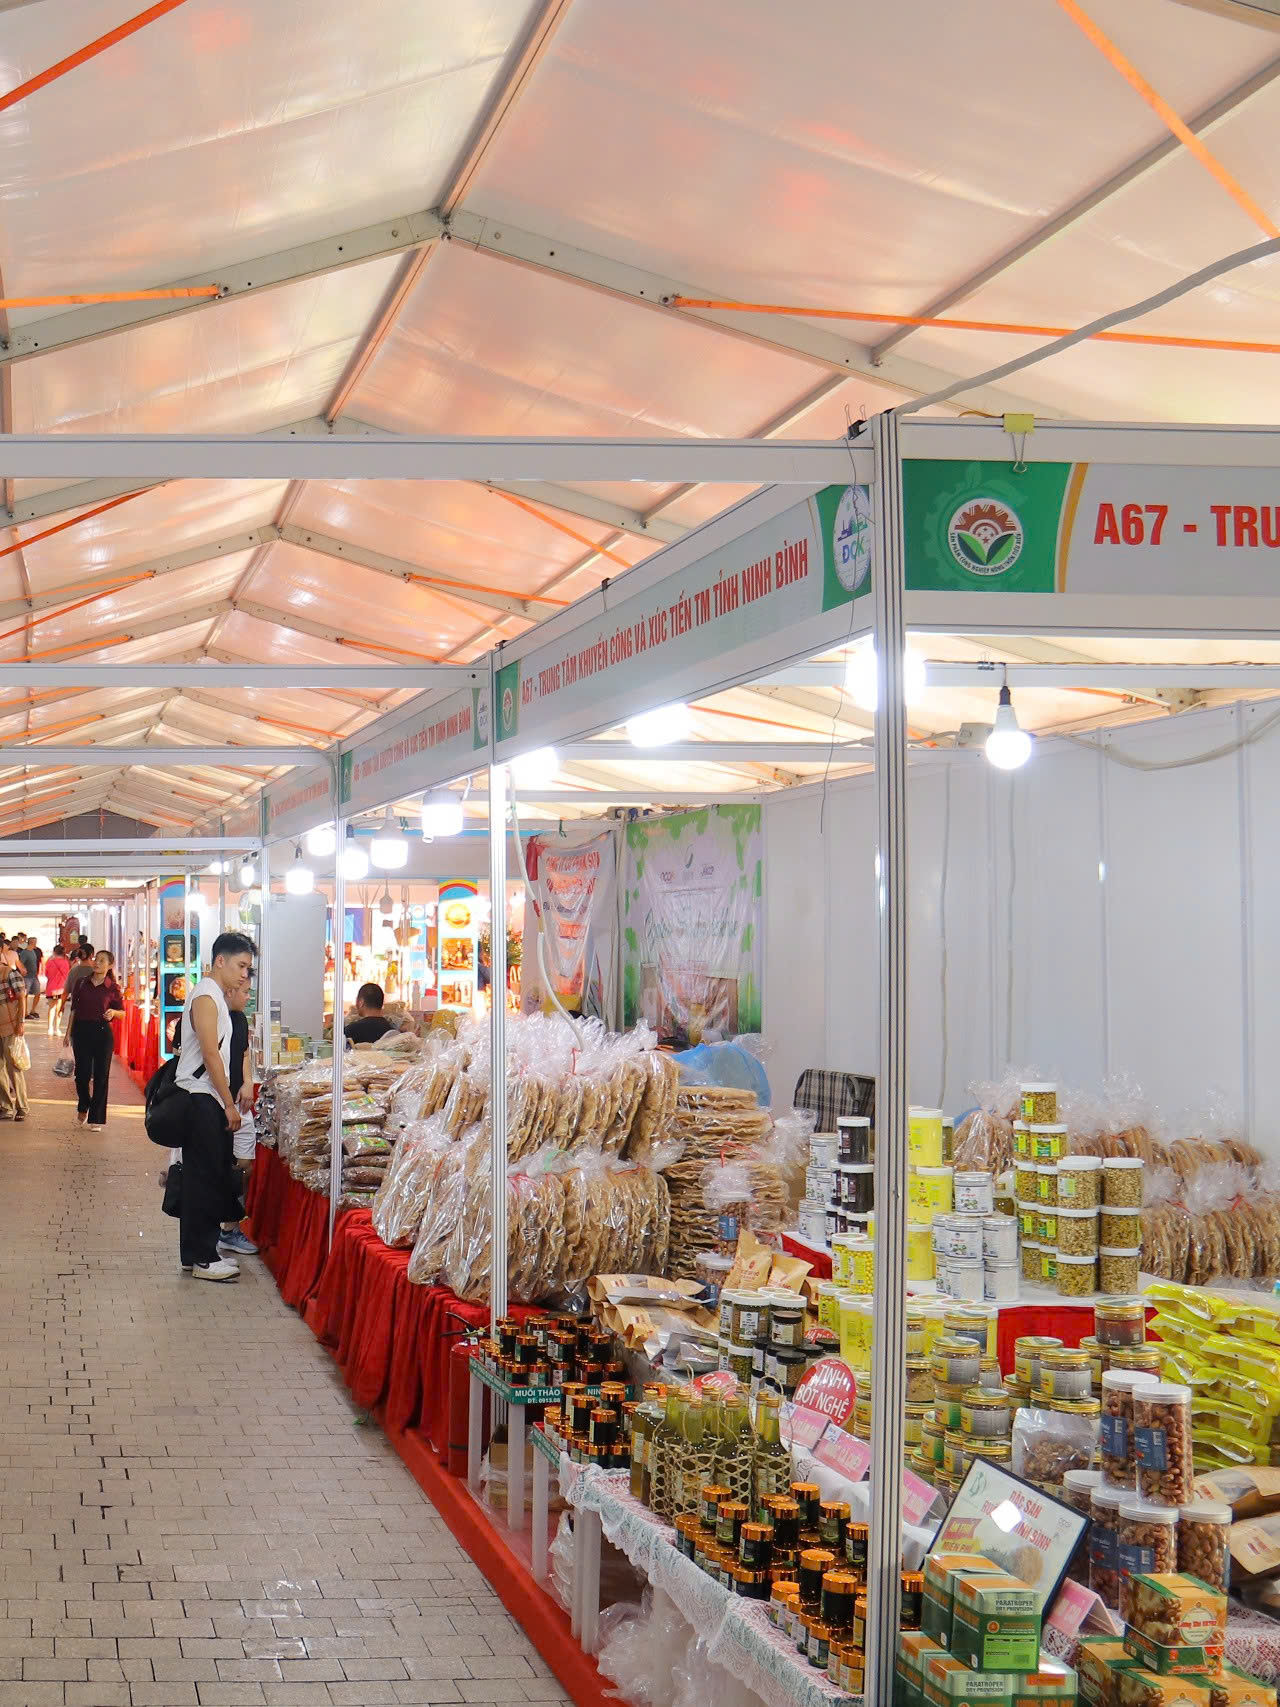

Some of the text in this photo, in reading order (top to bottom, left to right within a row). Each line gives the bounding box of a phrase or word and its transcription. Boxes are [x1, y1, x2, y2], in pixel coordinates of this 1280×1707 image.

[1093, 503, 1280, 548] A67 - TRU
[538, 663, 561, 697] TRUNG
[561, 653, 577, 689] TÂM
[578, 632, 608, 680] KHUYẾN
[609, 627, 632, 666] CÔNG
[634, 614, 647, 653] VÀ
[648, 608, 668, 646] XÚC
[669, 590, 692, 639] TIẾN
[694, 588, 711, 627] TM
[712, 569, 739, 618] TỈNH
[742, 556, 772, 604] NINH
[775, 540, 809, 590] BÌNH
[819, 1365, 848, 1390] TINH
[588, 1388, 601, 1396] NIN
[1023, 1498, 1043, 1519] SẢN
[1030, 1529, 1053, 1551] BÌNH
